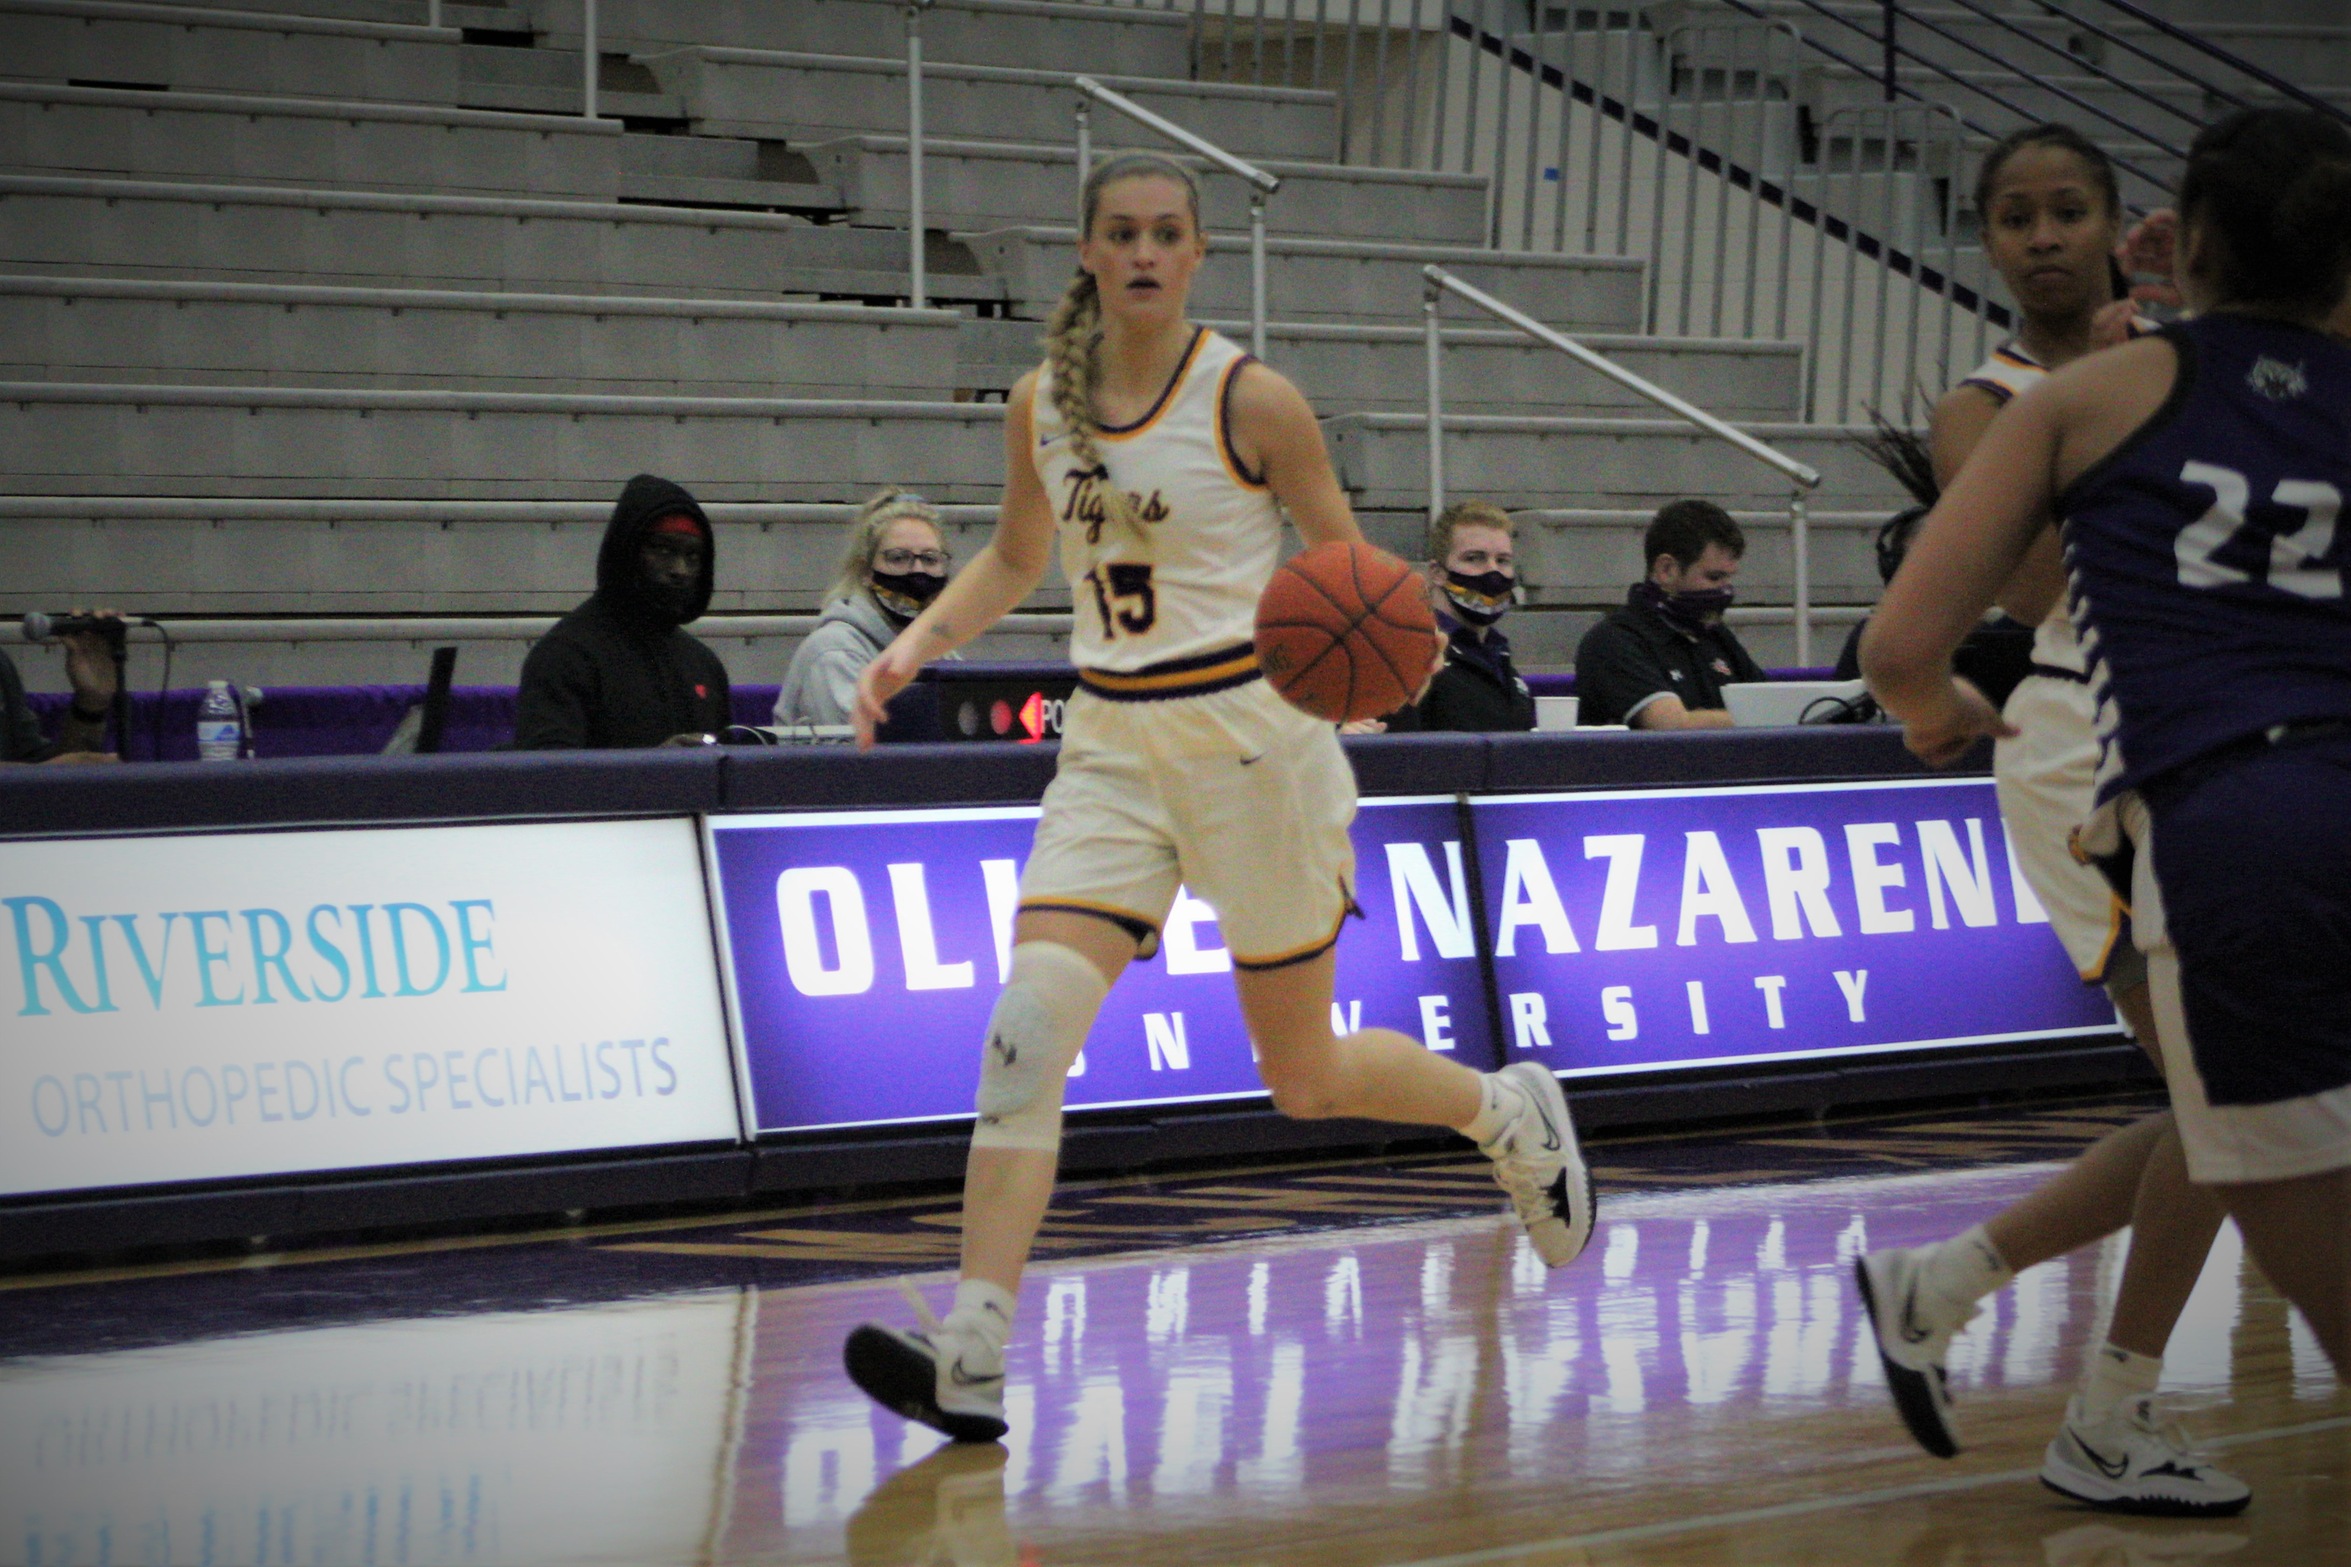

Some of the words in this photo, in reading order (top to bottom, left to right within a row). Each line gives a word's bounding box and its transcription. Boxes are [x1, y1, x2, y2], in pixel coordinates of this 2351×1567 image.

[1061, 463, 1171, 545] Tigrs
[2173, 459, 2344, 599] 22
[1083, 562, 1156, 641] 15
[1041, 698, 1065, 735] PO
[5, 895, 508, 1018] RIVERSIDE
[776, 858, 1233, 998] OLIE
[1066, 968, 1869, 1078] NVERSITY
[30, 1055, 375, 1138] ORTHOPEDIC
[382, 1036, 679, 1114] SPECIALISTS
